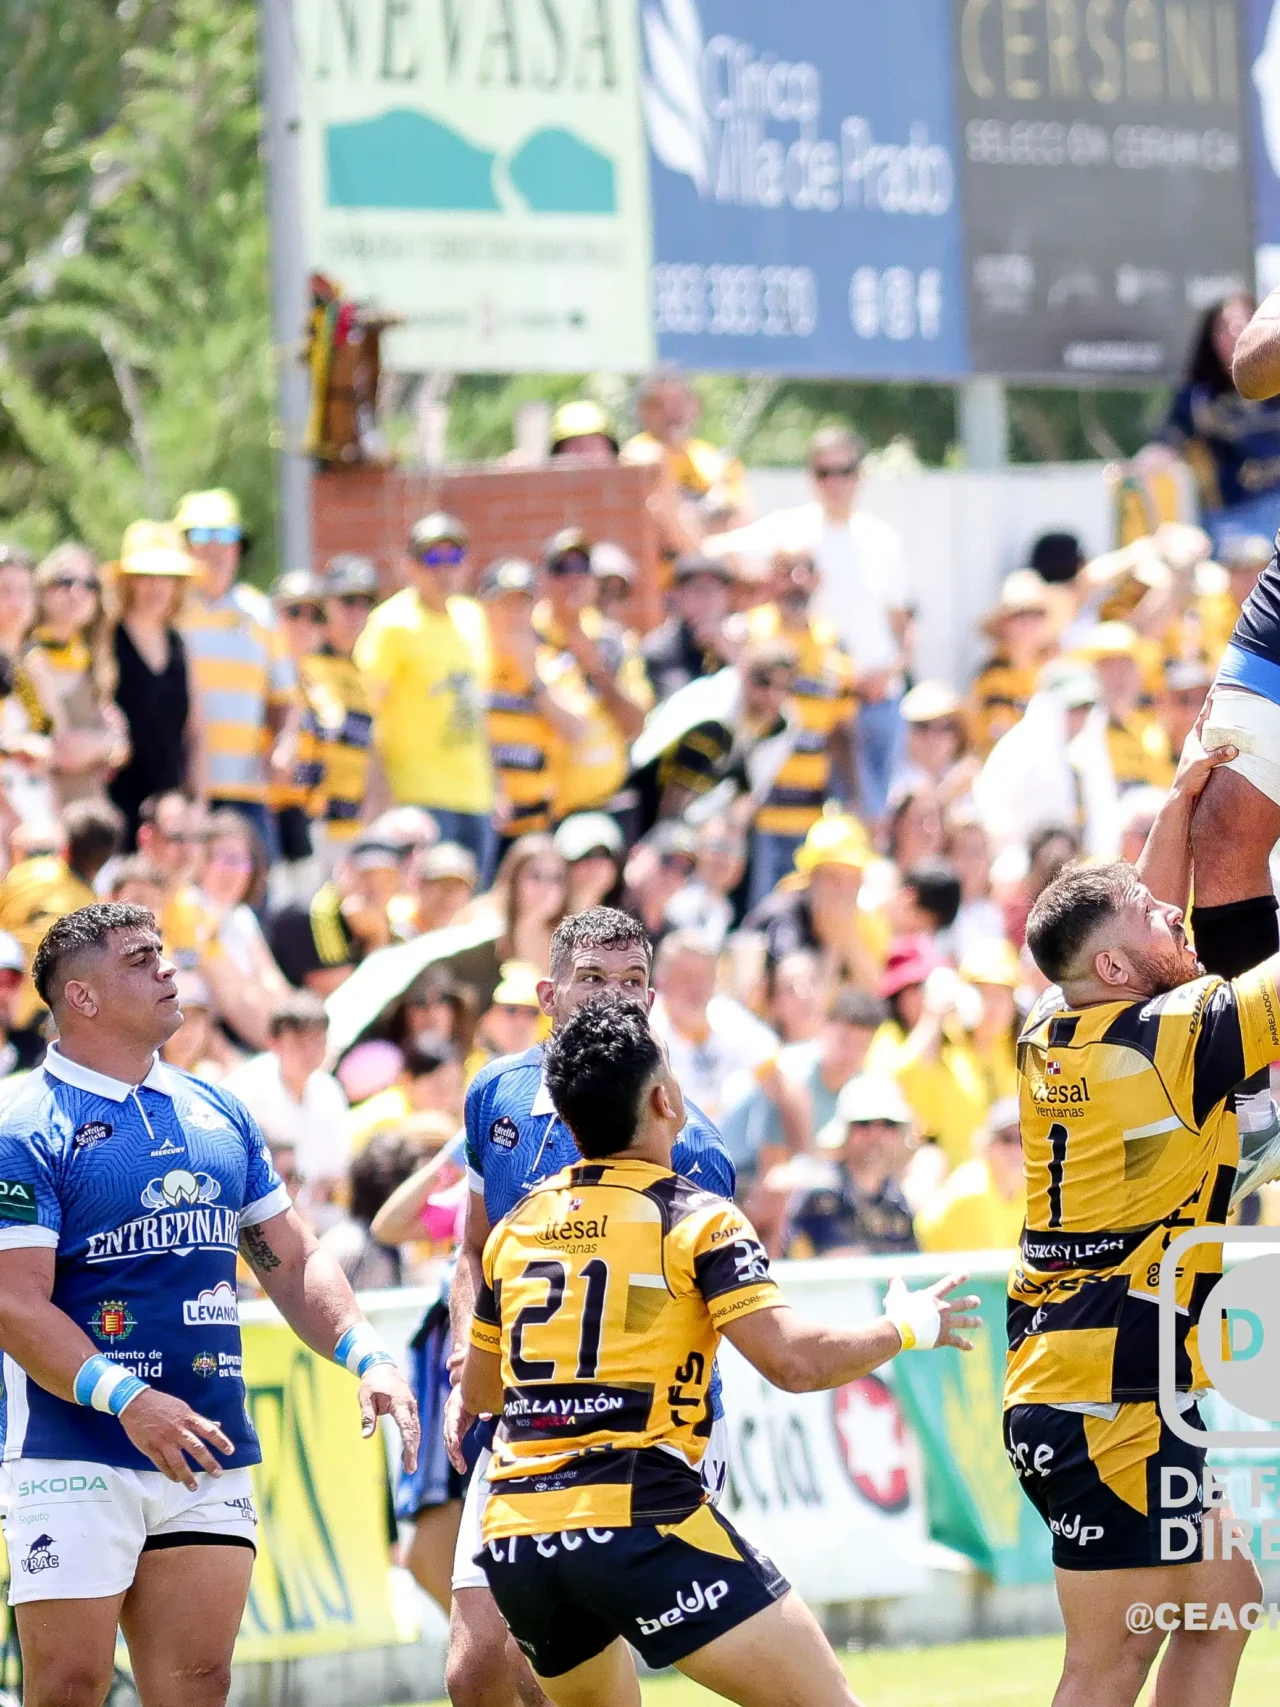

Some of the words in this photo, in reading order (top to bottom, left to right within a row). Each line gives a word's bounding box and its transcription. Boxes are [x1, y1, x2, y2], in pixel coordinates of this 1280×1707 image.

[1035, 1106, 1084, 1118] ventanas
[151, 1147, 185, 1157] MERCURY
[1046, 1121, 1071, 1229] 1
[508, 1258, 609, 1383] 21
[148, 1350, 162, 1360] de
[560, 1399, 572, 1415] Y
[574, 1393, 623, 1414] LEÓN
[21, 1555, 59, 1572] VRAC
